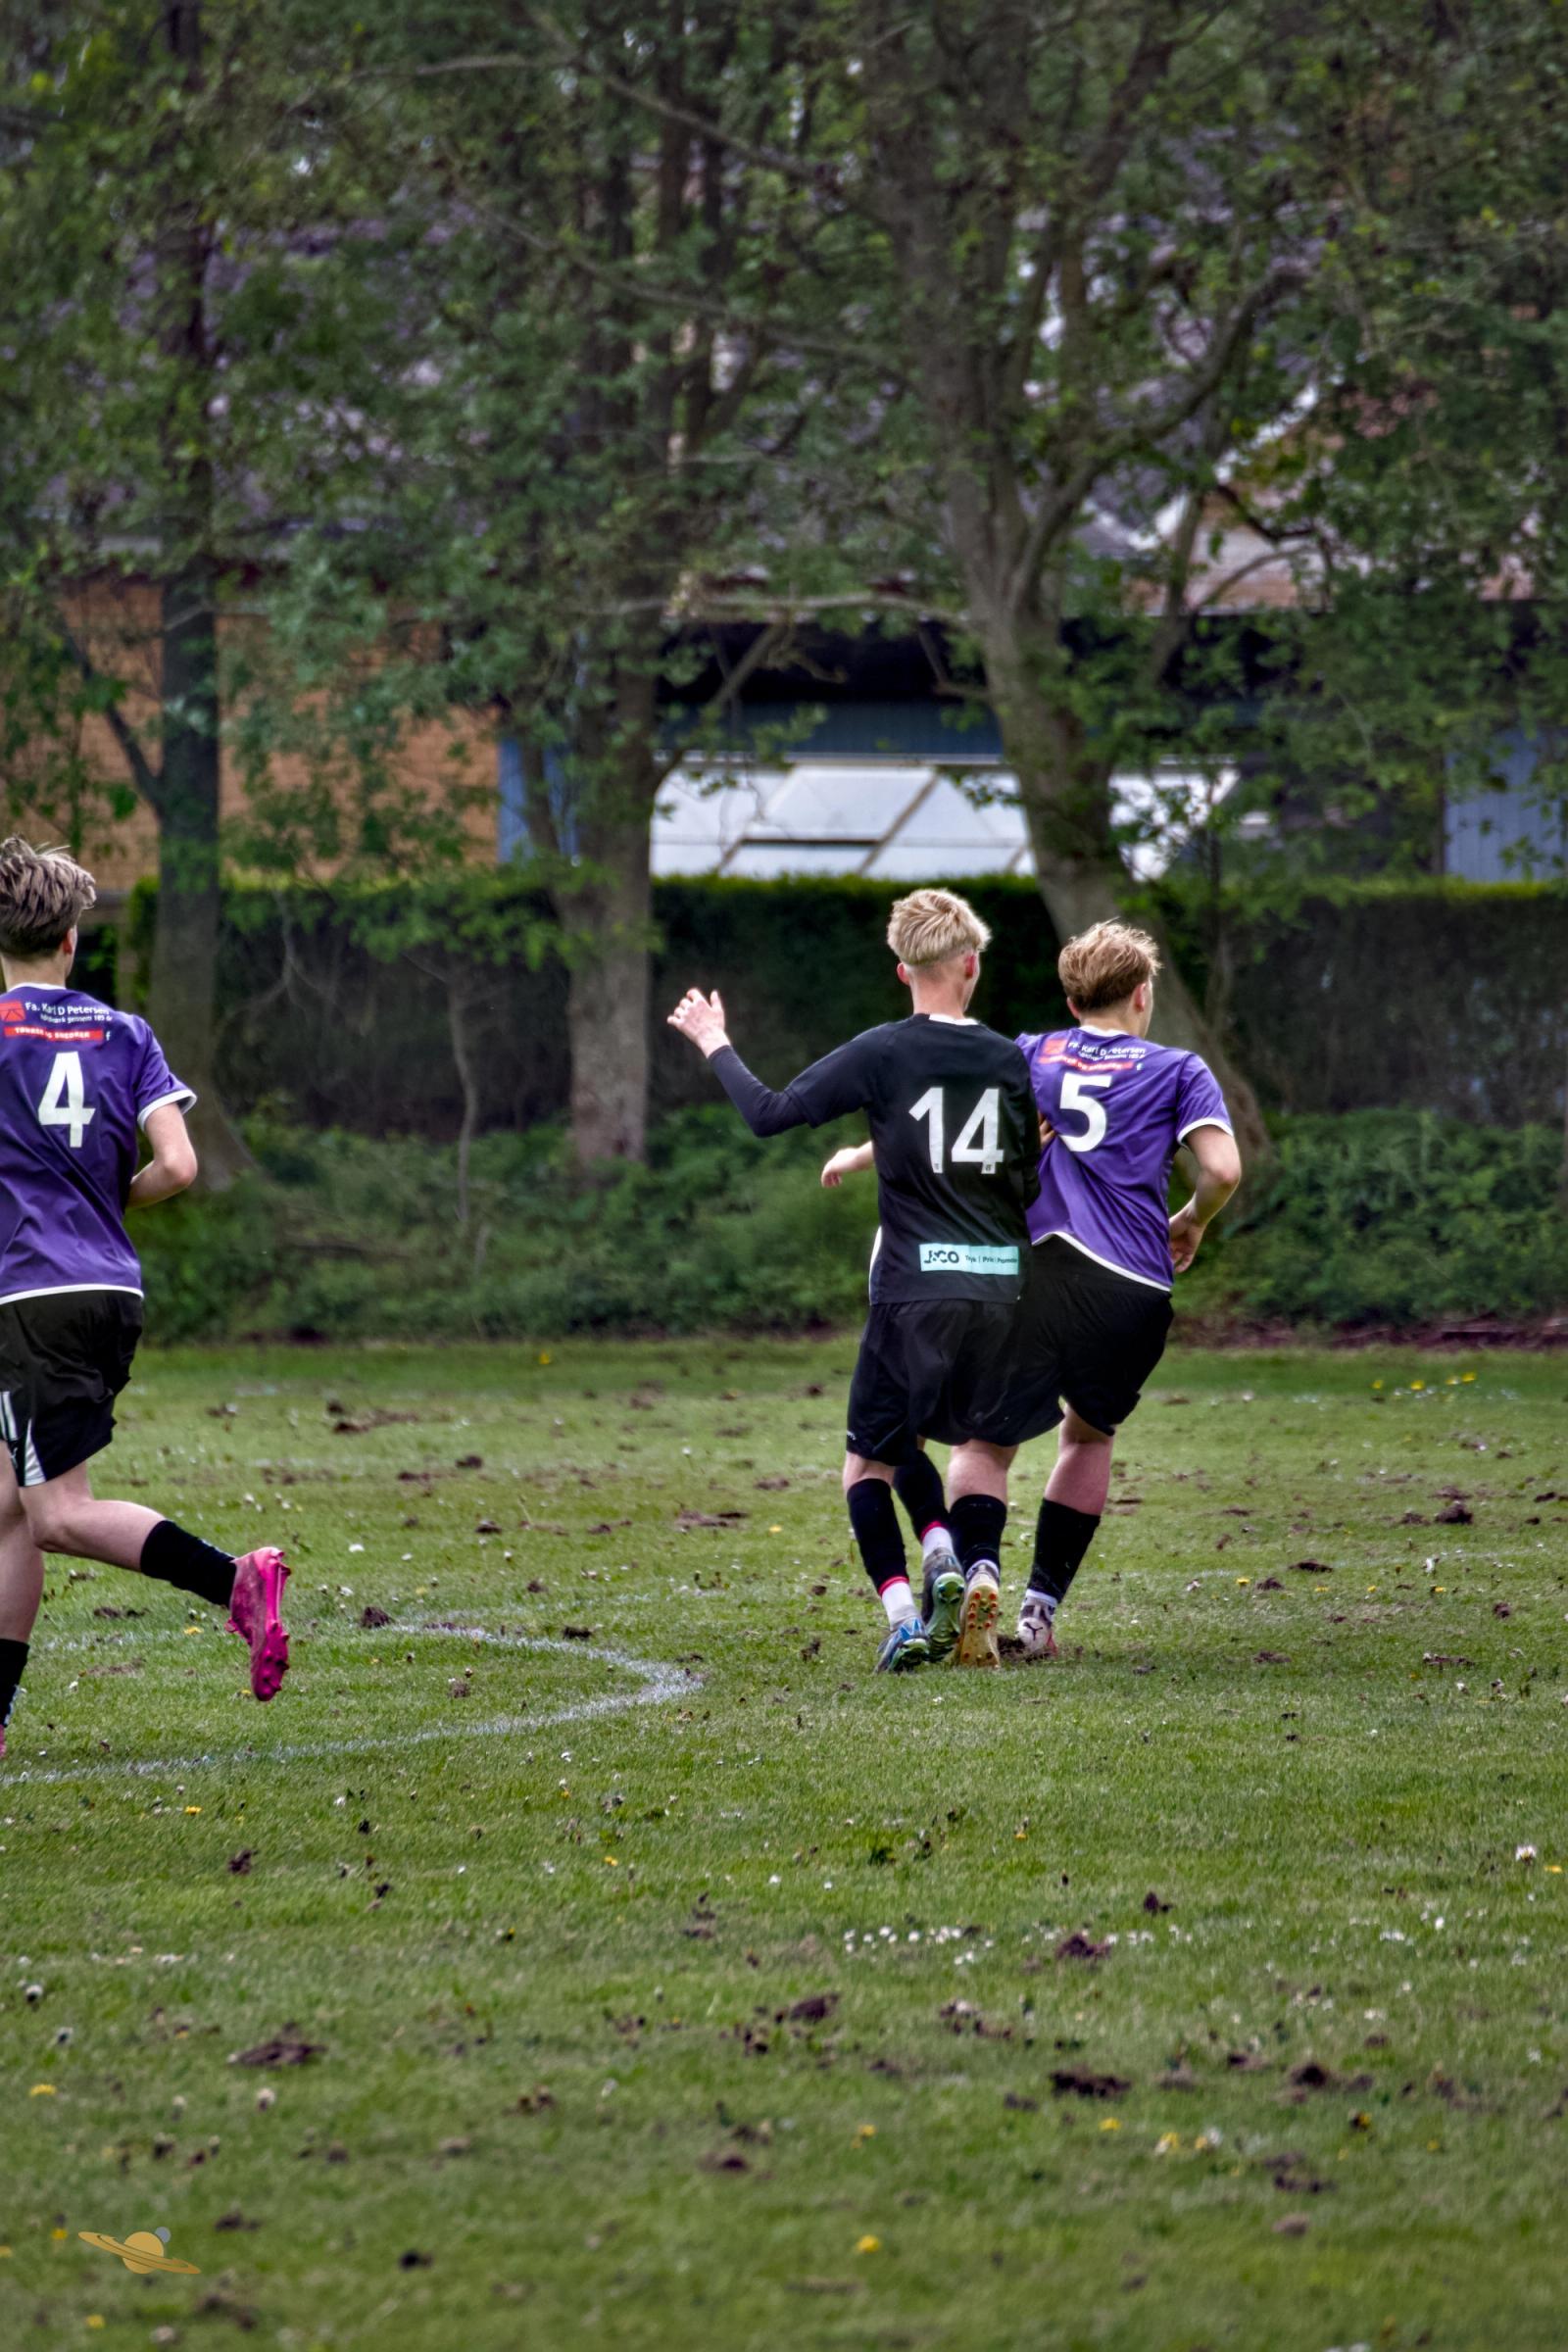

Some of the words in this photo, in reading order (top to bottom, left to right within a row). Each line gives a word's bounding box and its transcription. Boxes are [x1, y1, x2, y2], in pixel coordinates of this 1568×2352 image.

[24, 1002, 40, 1011] Fa.
[57, 1006, 66, 1016] D
[67, 1004, 110, 1015] Petersen
[37, 1051, 96, 1149] 4
[907, 1086, 1004, 1175] 14
[1059, 1072, 1112, 1152] 5
